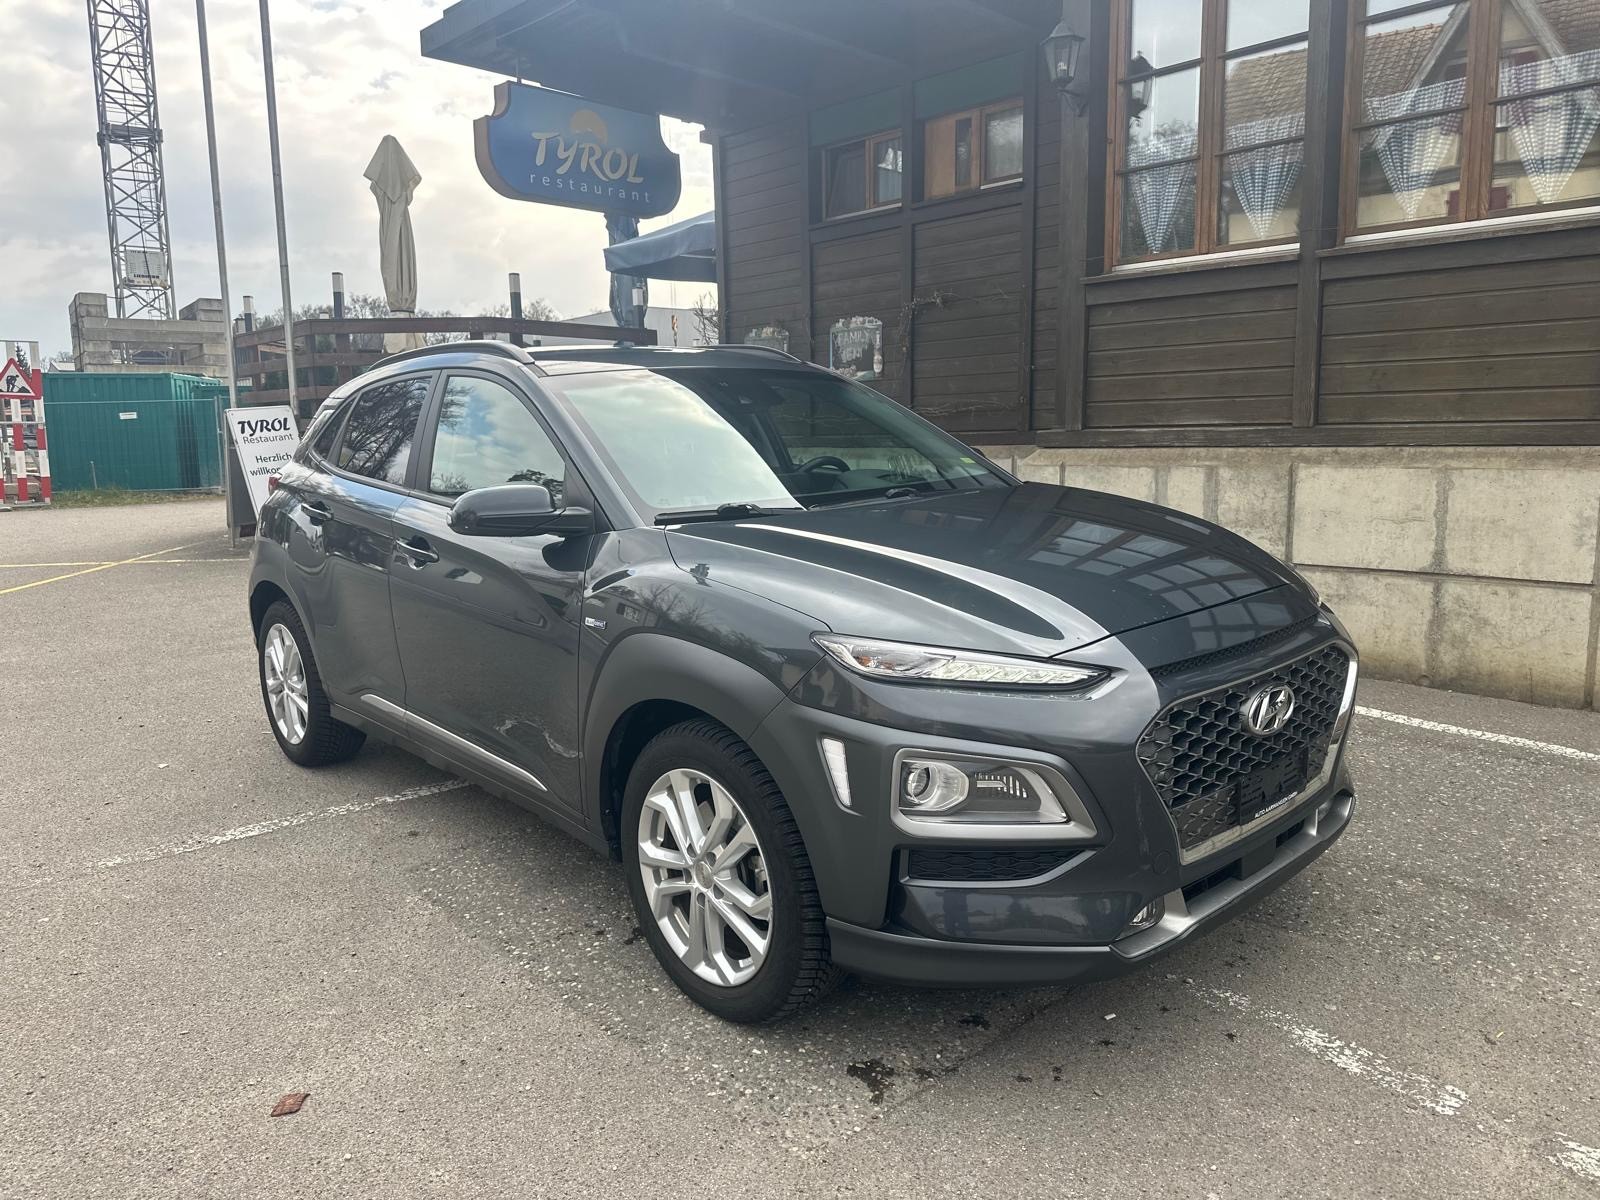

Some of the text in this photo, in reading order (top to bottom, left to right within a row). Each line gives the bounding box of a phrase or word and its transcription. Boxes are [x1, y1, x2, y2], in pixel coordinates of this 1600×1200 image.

[531, 131, 644, 184] TYROL
[529, 172, 650, 202] restaurant
[237, 417, 290, 437] TYROL
[242, 433, 294, 445] Restaurant
[255, 452, 292, 463] Herzlich
